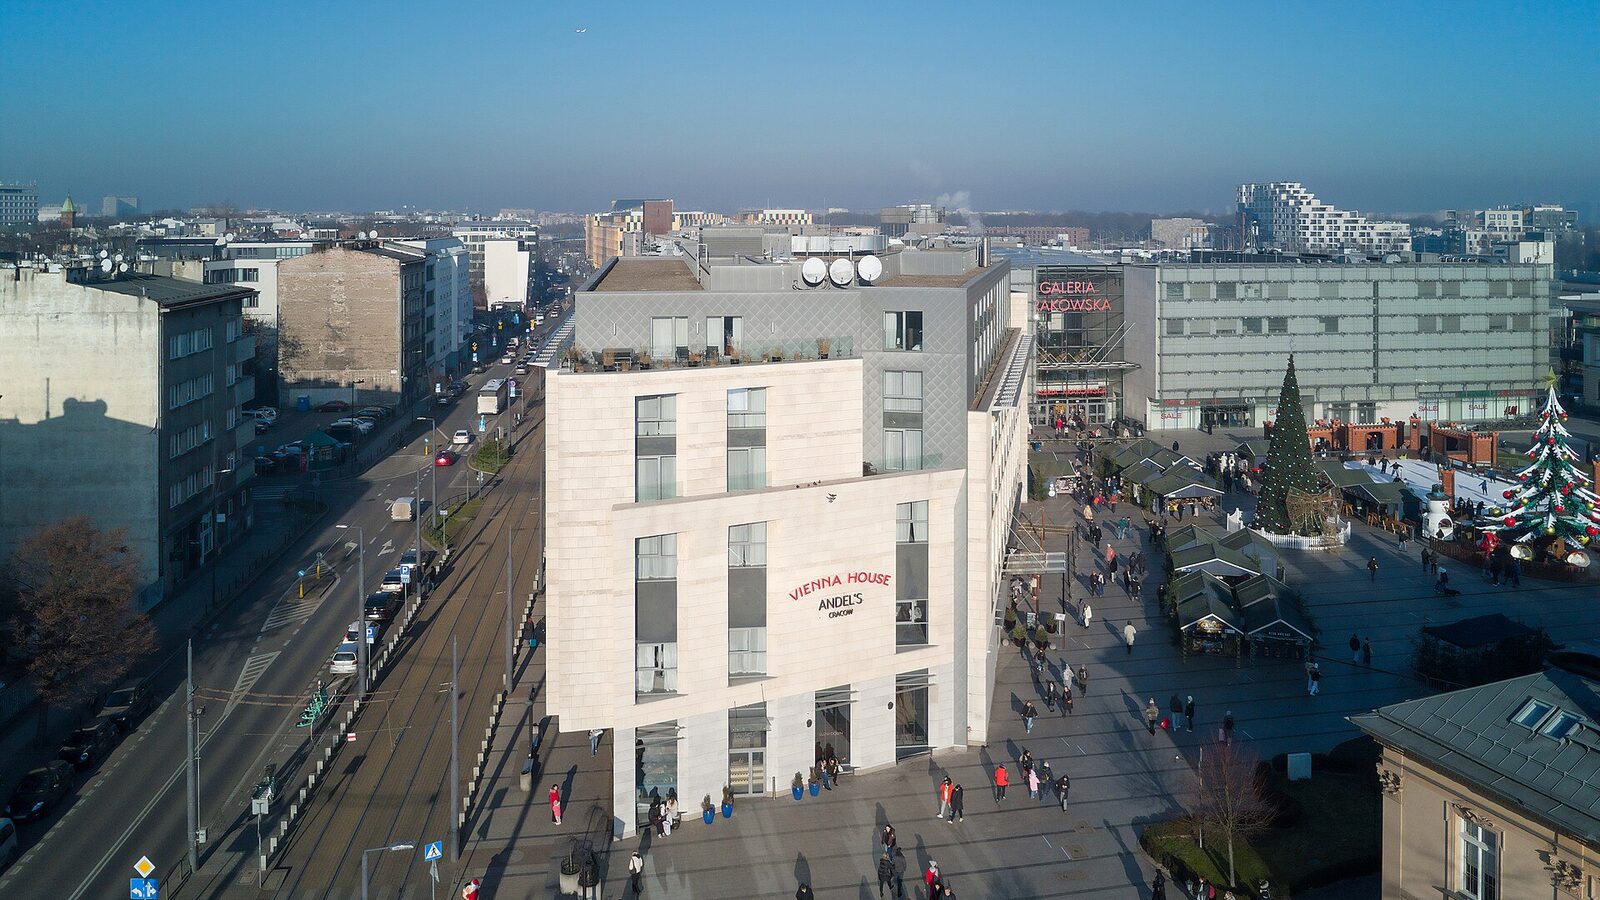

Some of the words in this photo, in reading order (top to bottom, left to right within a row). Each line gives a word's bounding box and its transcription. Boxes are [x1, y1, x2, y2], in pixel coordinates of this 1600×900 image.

[1040, 281, 1095, 294] GALERIA
[789, 575, 842, 601] VIENNA
[847, 571, 892, 587] HOUSE
[818, 593, 864, 611] ANDEL'S
[828, 608, 854, 619] CRACOW
